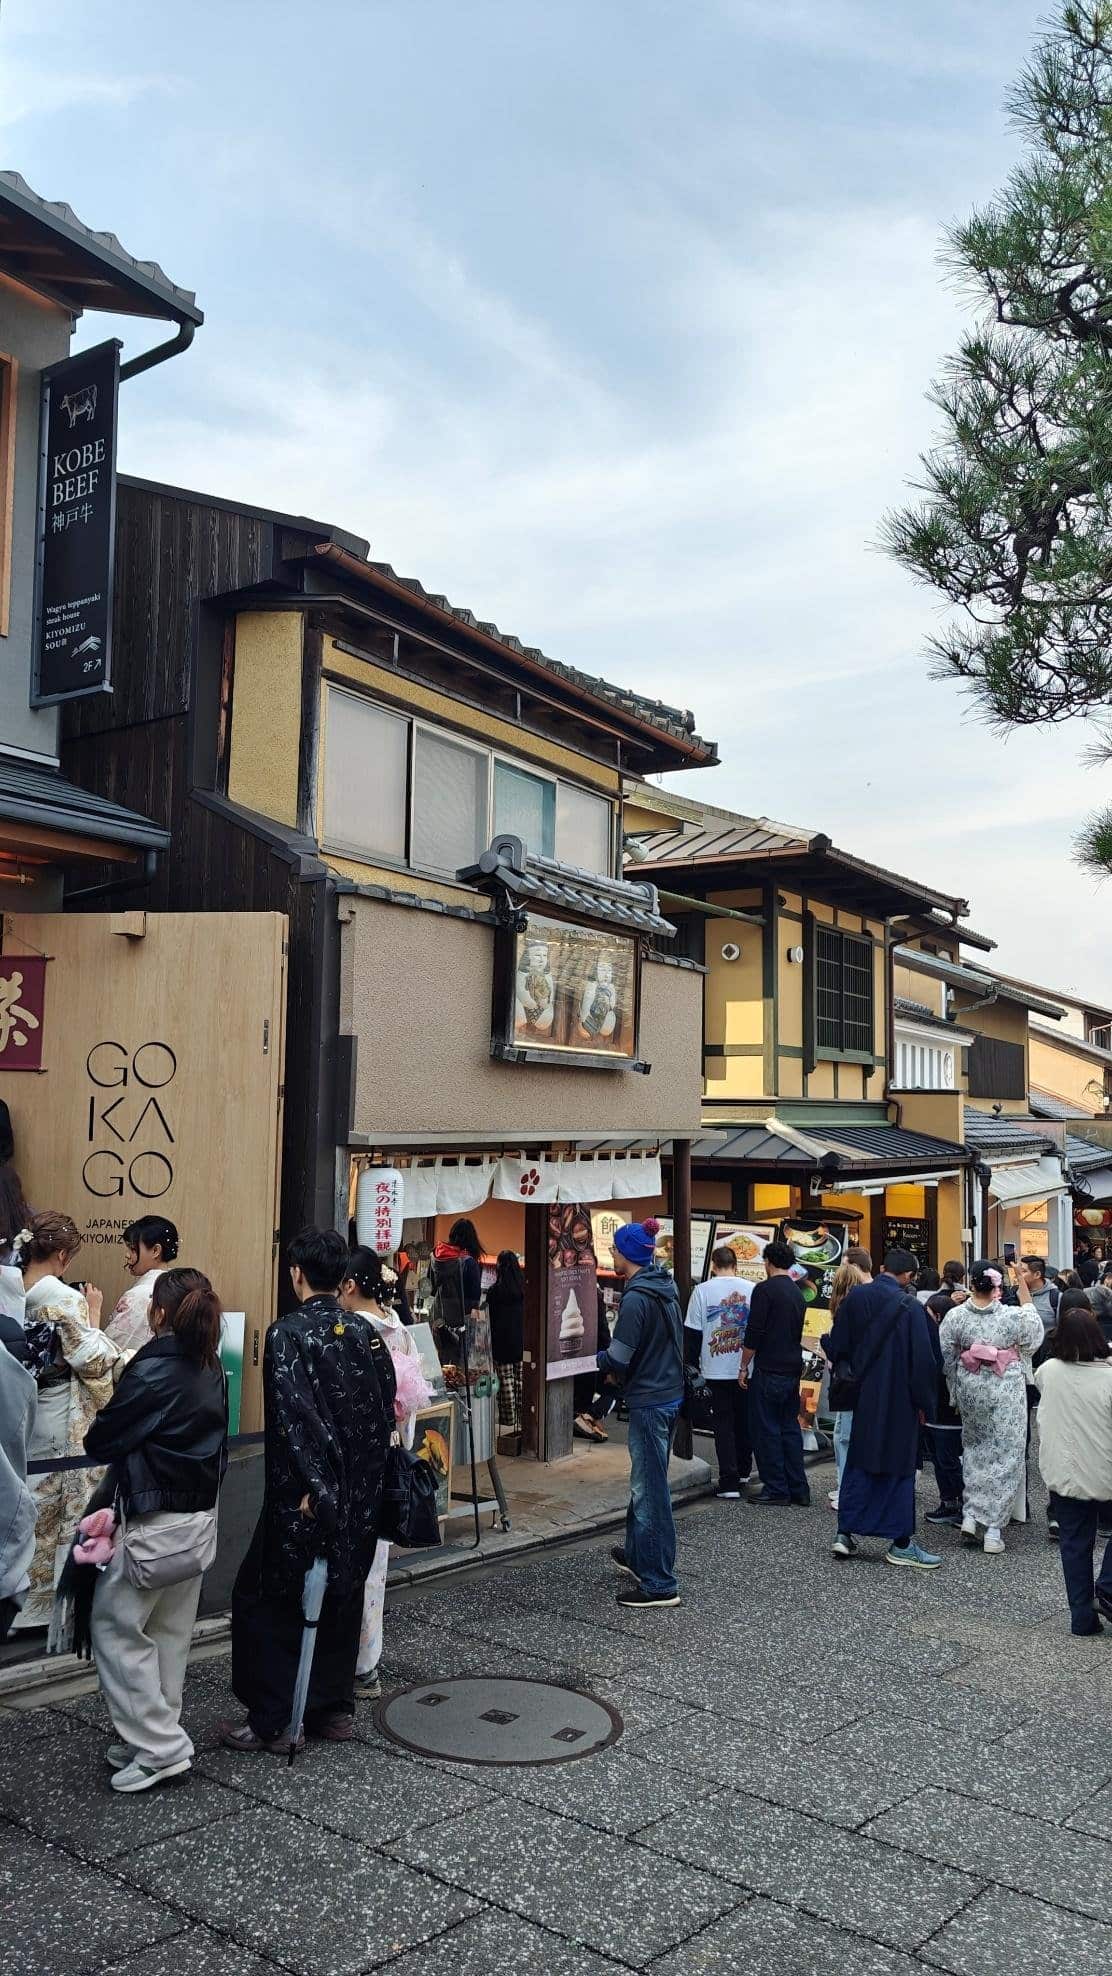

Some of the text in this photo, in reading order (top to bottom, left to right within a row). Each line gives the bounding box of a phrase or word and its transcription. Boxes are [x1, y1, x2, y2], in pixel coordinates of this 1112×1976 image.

[53, 439, 106, 478] KOBE
[52, 469, 99, 506] BEEF
[51, 503, 94, 534] 神戸牛
[45, 622, 86, 640] KIYOMIZU
[62, 611, 81, 621] house
[83, 660, 94, 673] 2F
[86, 1041, 177, 1088] GO
[82, 1150, 173, 1198] GO
